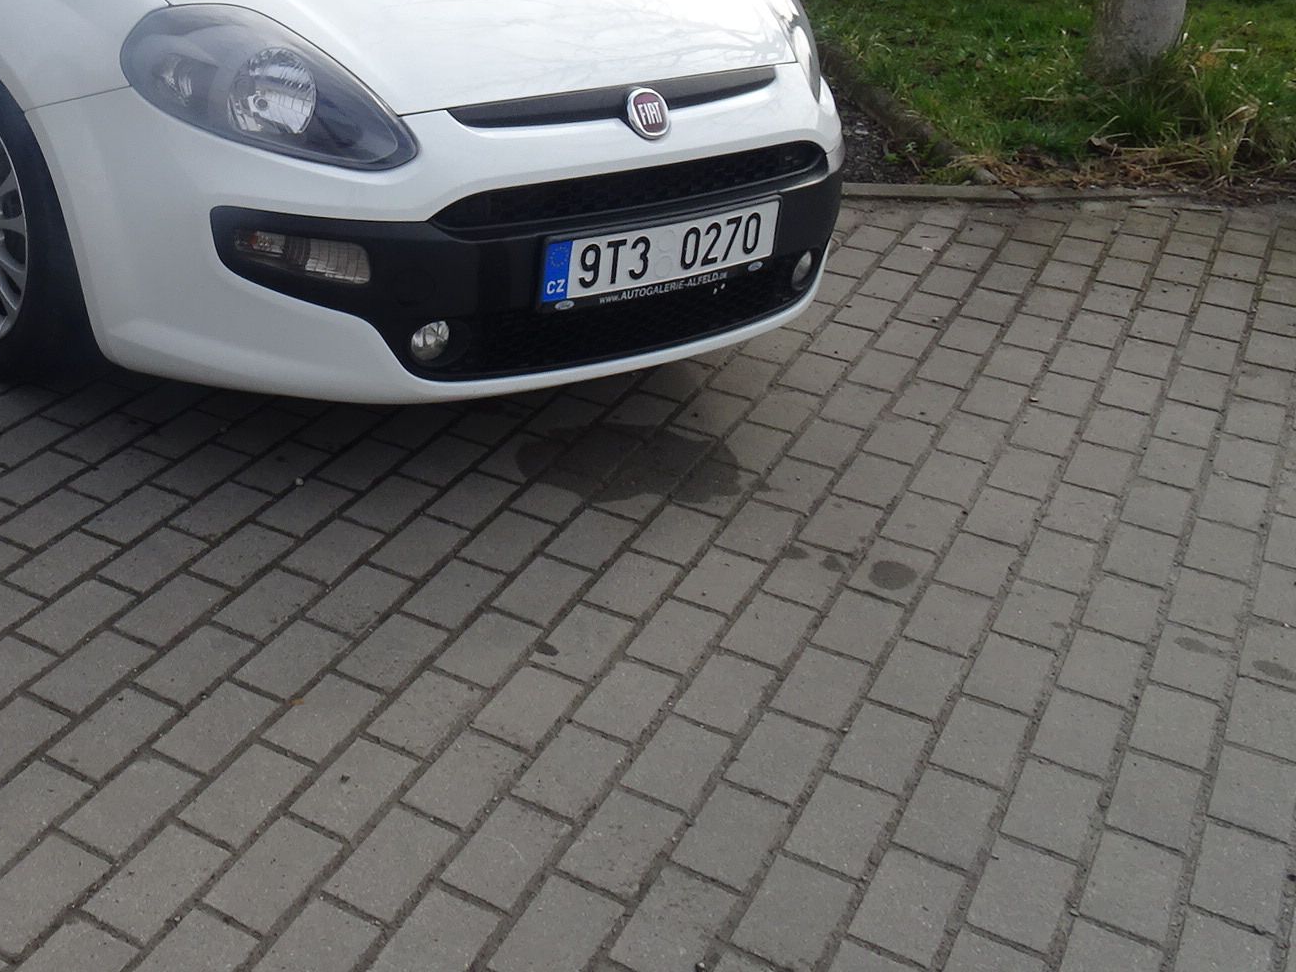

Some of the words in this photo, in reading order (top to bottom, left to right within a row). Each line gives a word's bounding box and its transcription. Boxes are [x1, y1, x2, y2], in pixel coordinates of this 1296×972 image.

[636, 101, 663, 126] FIAT
[577, 236, 651, 289] 9T3
[680, 212, 762, 271] 0270
[546, 278, 565, 295] CZ
